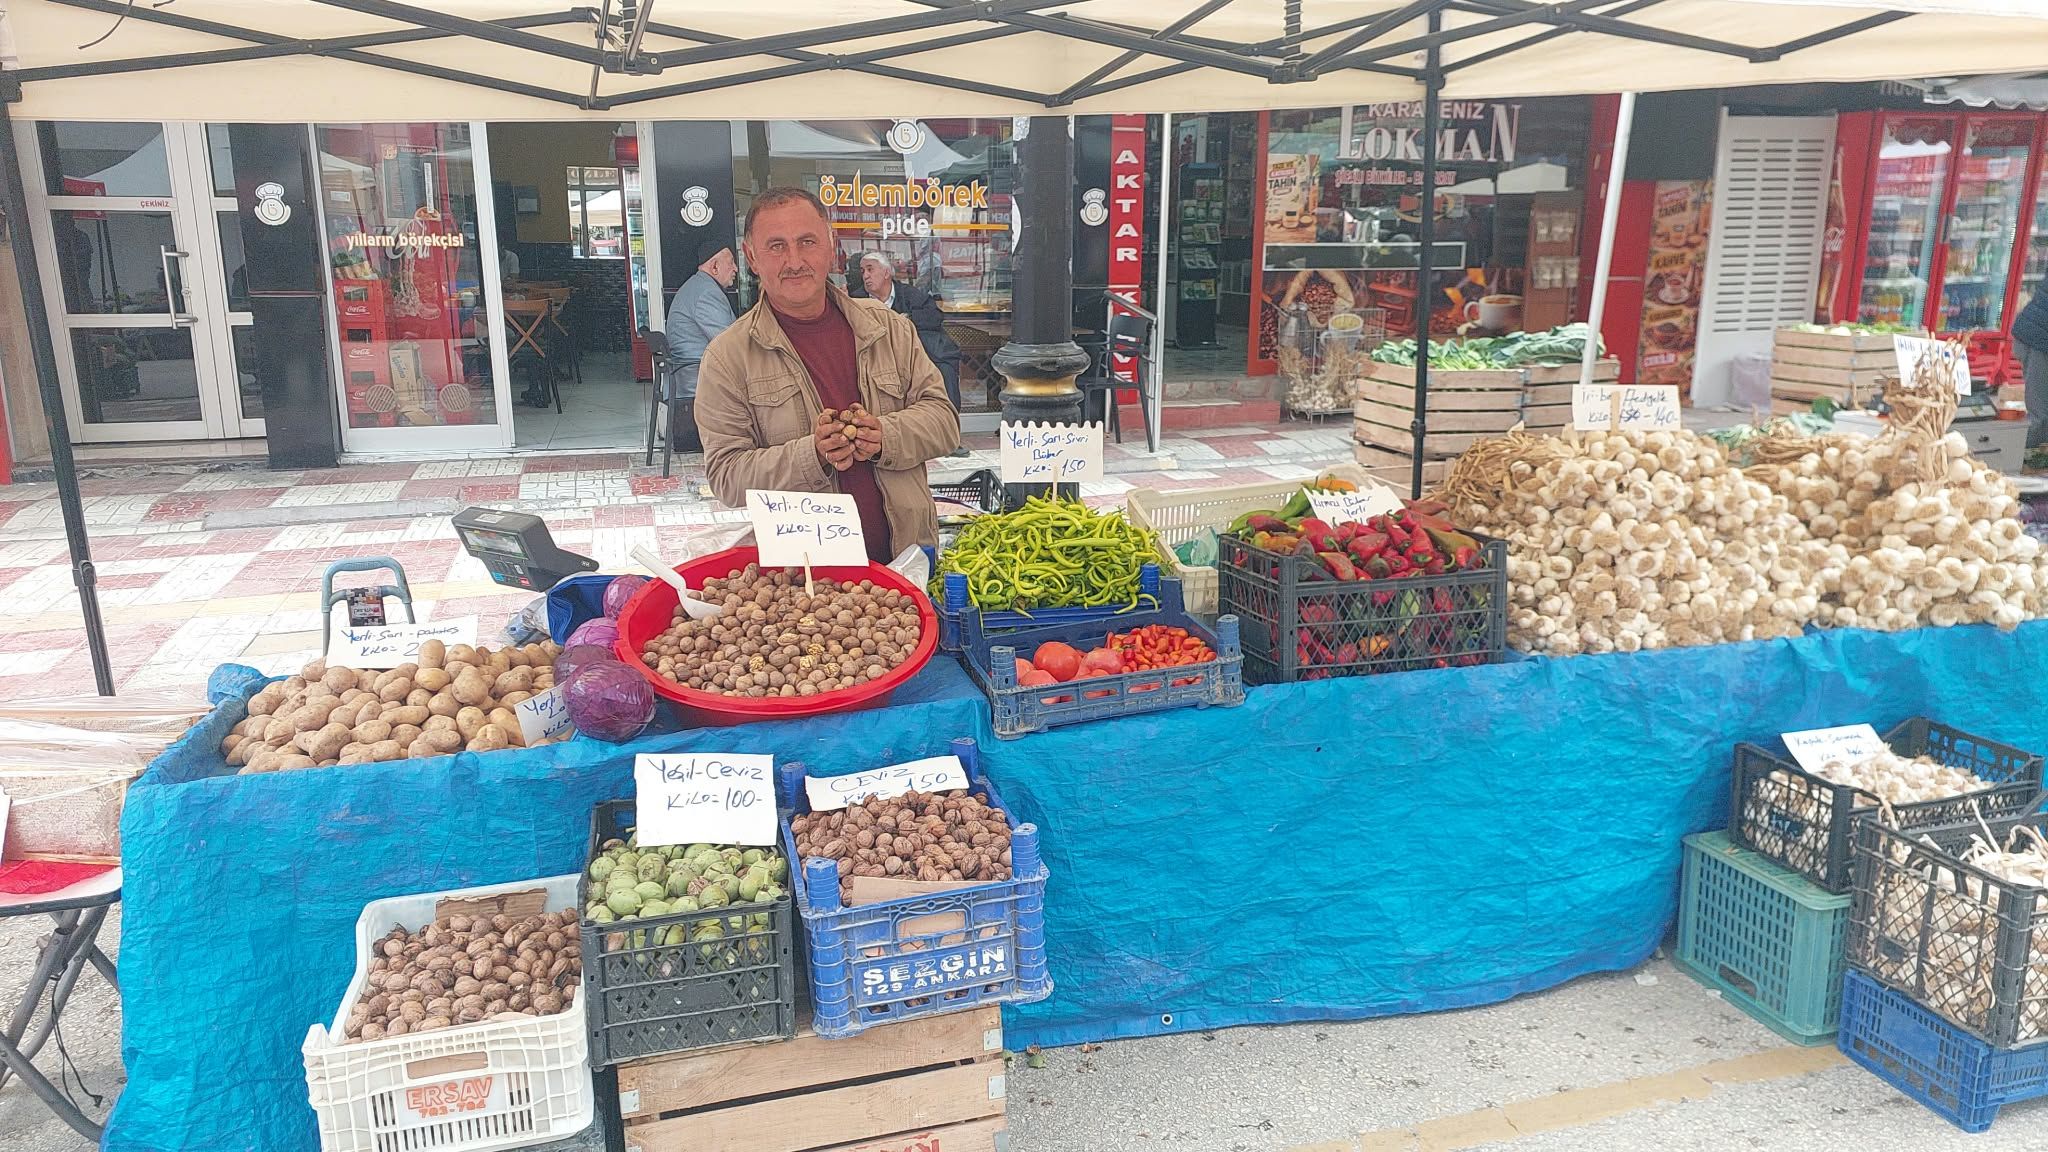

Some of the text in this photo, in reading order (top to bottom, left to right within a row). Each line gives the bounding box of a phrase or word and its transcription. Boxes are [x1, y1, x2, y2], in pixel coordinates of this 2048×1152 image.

[819, 168, 988, 209] özlembörek
[1115, 149, 1141, 263] AKTAR
[882, 213, 929, 240] pide
[346, 231, 465, 251] yılların börekçisi
[1061, 458, 1086, 477] 150
[913, 962, 1007, 989] ANKARA
[406, 1076, 493, 1111] ERSAV
